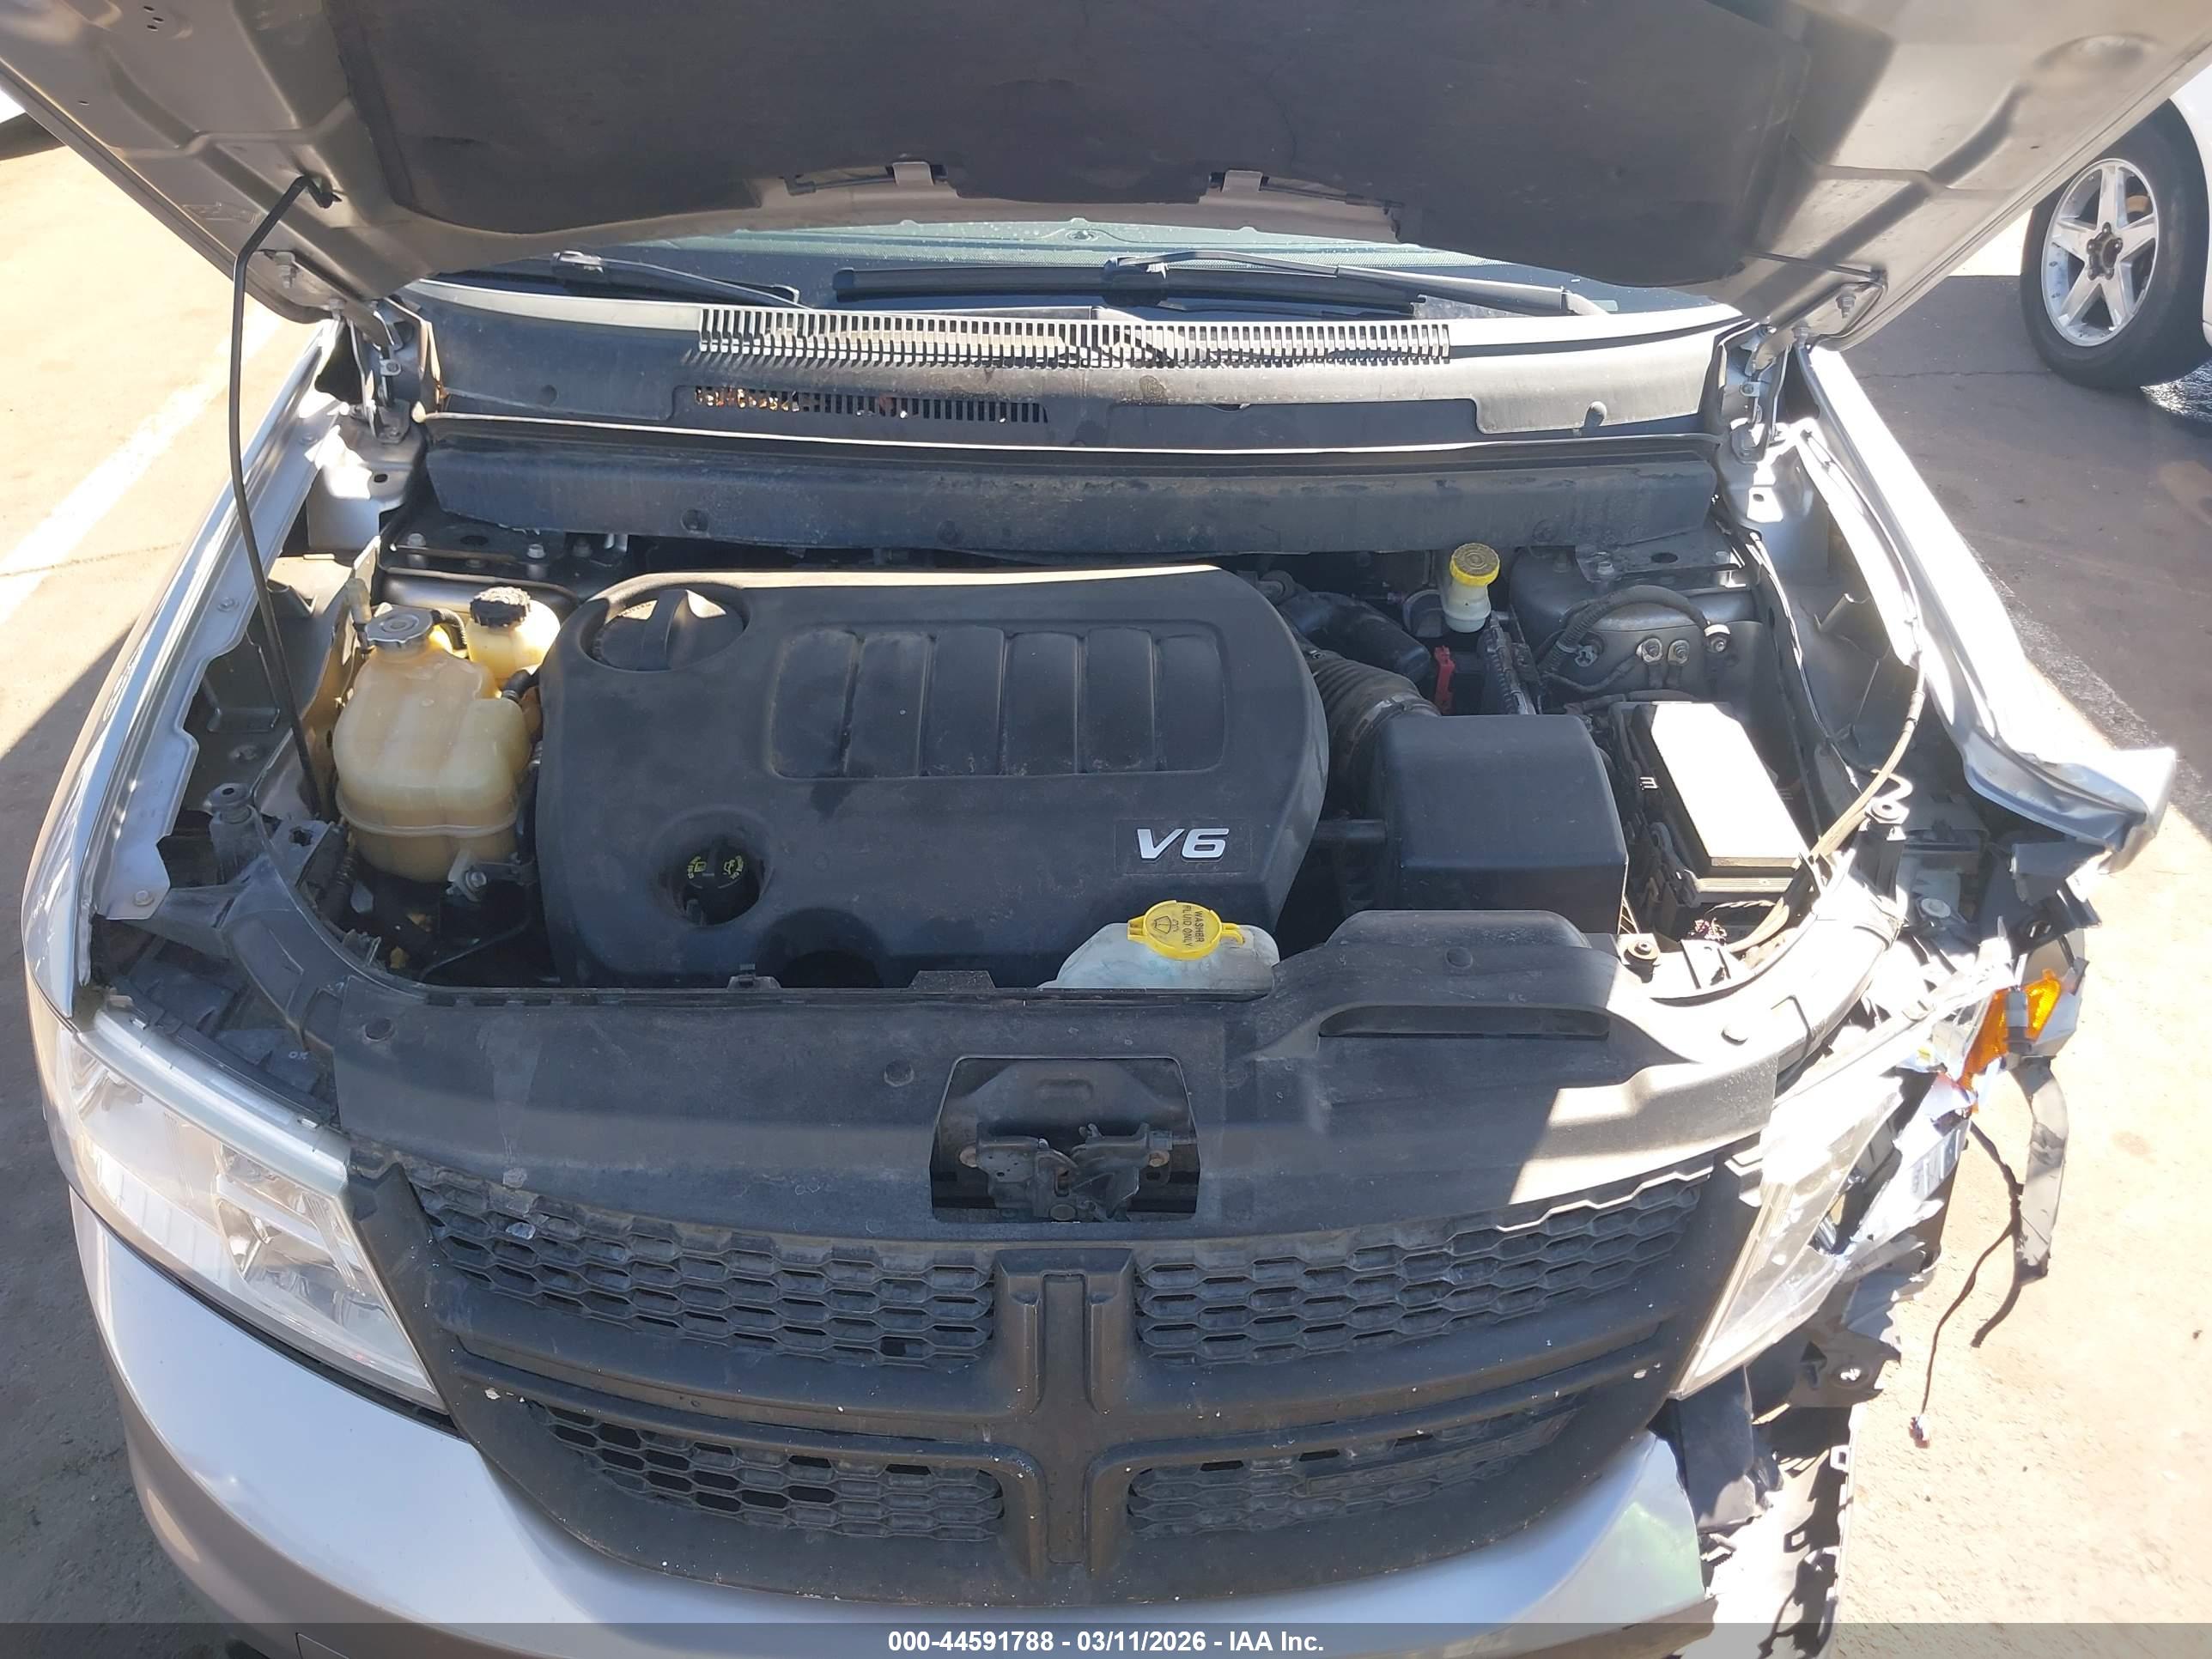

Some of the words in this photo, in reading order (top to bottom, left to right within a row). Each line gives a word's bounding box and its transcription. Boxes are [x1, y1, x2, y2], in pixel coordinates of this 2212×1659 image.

[1137, 828, 1230, 860] V6
[1182, 905, 1192, 928] FLUID
[1194, 911, 1206, 943] WASHER
[1183, 928, 1194, 947] ONLY
